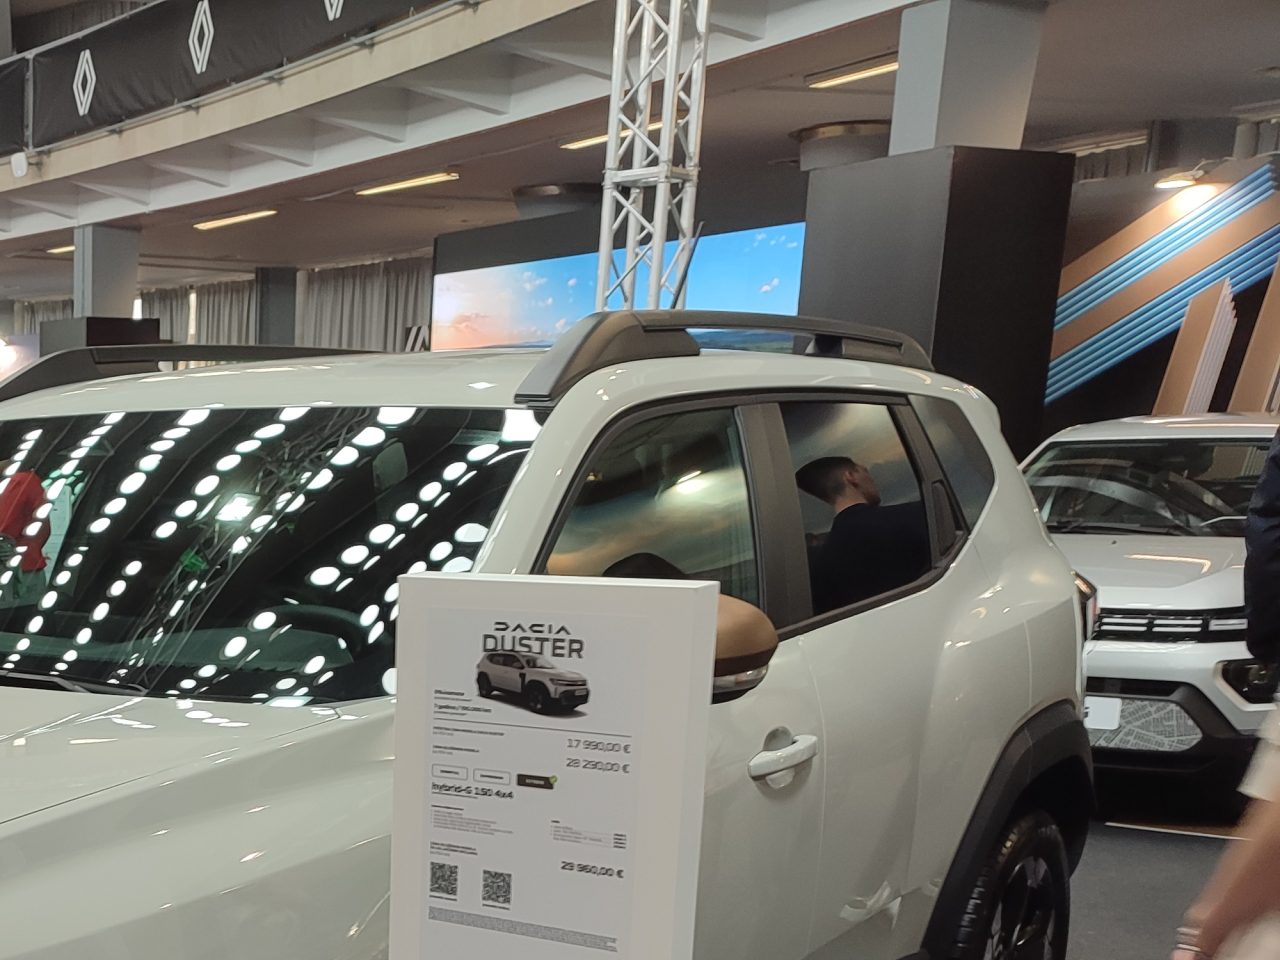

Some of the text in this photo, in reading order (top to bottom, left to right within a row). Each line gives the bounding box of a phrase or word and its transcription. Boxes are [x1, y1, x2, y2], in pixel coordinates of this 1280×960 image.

[493, 621, 572, 635] DACIA
[483, 634, 585, 659] DUSTER
[567, 738, 581, 748] 17
[623, 744, 631, 754] €
